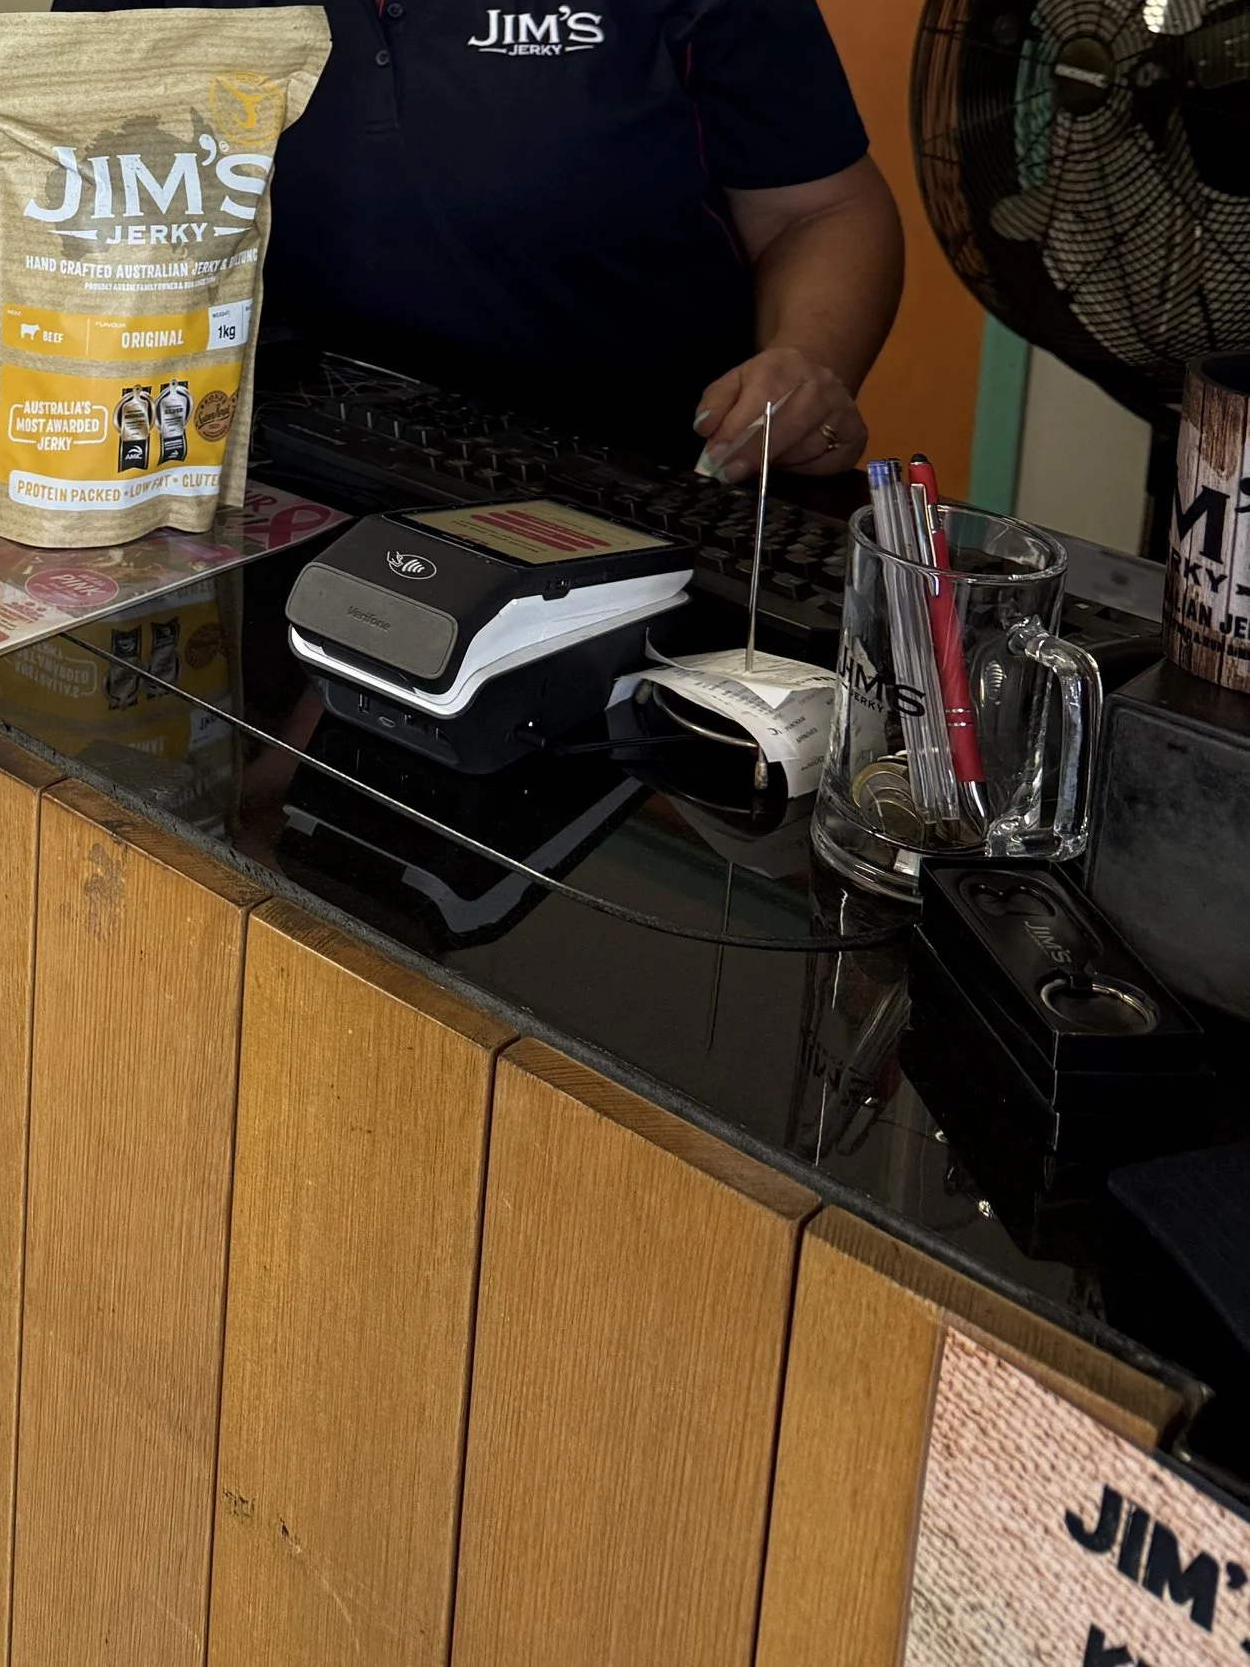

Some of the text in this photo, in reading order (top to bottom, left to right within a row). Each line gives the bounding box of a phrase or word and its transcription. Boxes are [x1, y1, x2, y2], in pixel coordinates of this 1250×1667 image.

[467, 5, 604, 47] JIM'S
[508, 45, 562, 56] JERKY
[23, 134, 274, 222] JIM'S
[106, 223, 208, 245] JERKY
[25, 255, 57, 272] HAND
[60, 259, 112, 278] CRAFTED
[116, 262, 188, 279] AUSTRALIAN
[191, 260, 218, 276] JERKY
[43, 324, 236, 349] BEEF ORIGINAL 1kg
[23, 400, 91, 414] AUSTRALIA'S
[16, 418, 99, 433] MOST AWARDED
[37, 437, 72, 451] JERKY
[18, 473, 220, 502] PROTEIN PACKED LOW FAT GLUTE
[51, 573, 106, 597] PINK
[347, 605, 391, 632] Verifone
[1065, 1484, 1248, 1633] JIM'
